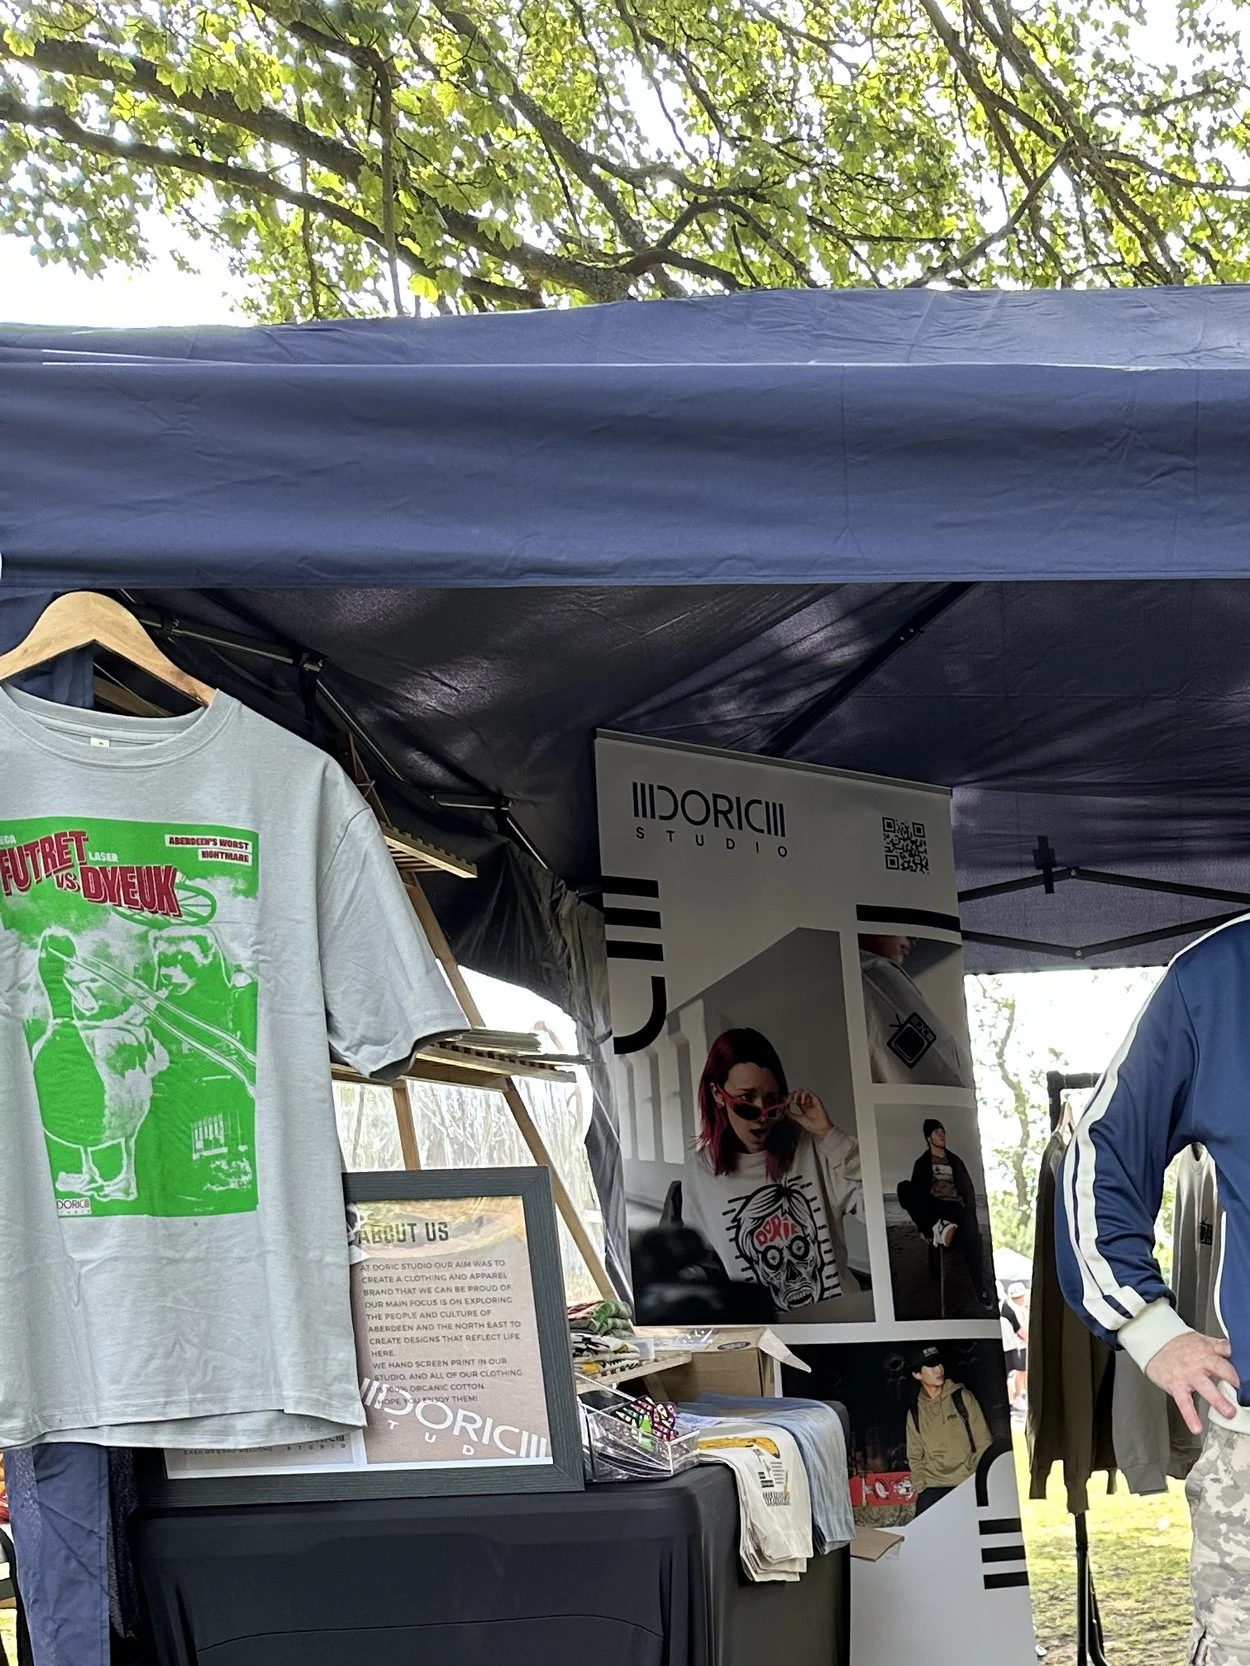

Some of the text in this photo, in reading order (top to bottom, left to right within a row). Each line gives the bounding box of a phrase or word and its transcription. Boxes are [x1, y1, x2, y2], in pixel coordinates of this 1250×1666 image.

[219, 838, 250, 850] WORST
[635, 826, 788, 857] STUDIO
[0, 831, 88, 896] FUTRET
[89, 852, 118, 863] LASER
[55, 872, 81, 892] VS
[80, 866, 182, 917] DYEUK
[358, 1221, 449, 1244] ABOUT US
[404, 1274, 446, 1282] CLOTHING
[465, 1297, 512, 1305] EXPLORING
[370, 1337, 401, 1345] CREATE
